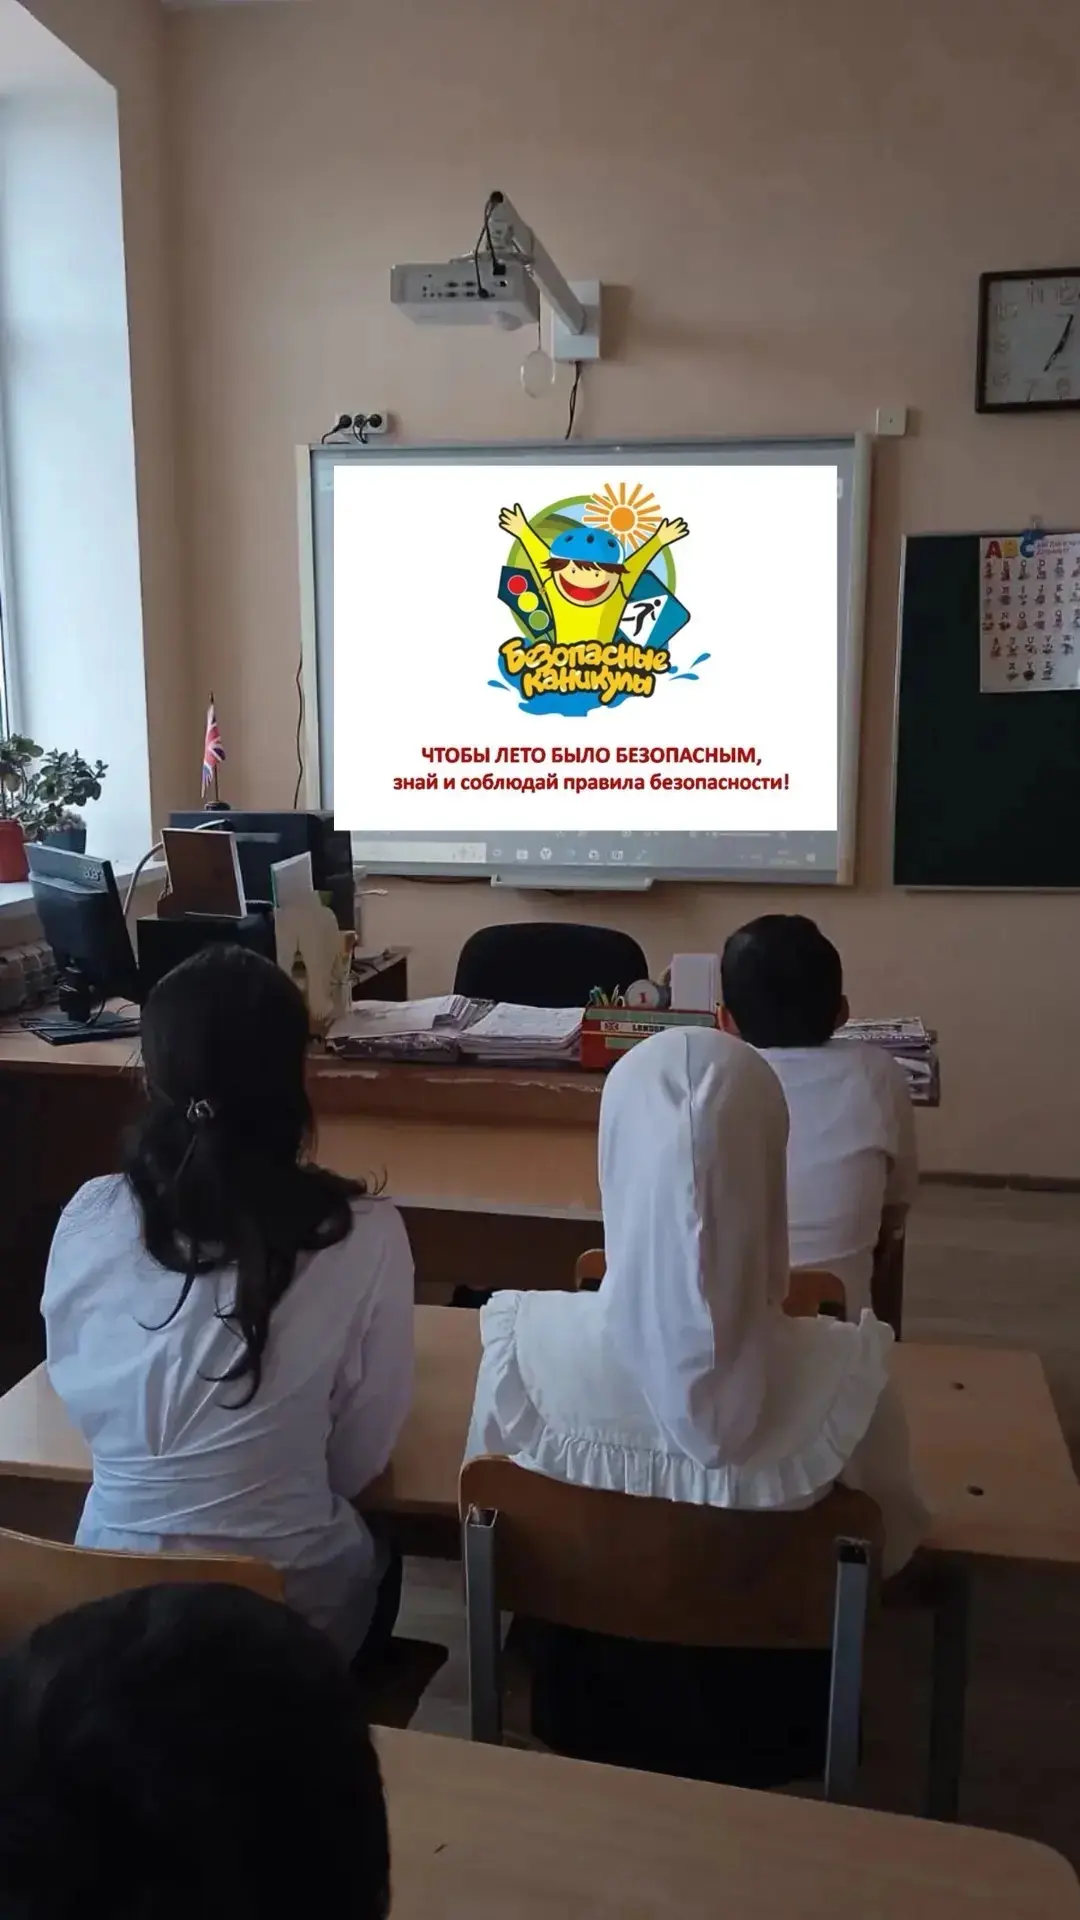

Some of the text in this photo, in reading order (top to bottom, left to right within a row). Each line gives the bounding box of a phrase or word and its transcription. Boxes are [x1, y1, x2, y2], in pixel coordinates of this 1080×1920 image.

[501, 638, 669, 674] Безопасные
[421, 746, 762, 767] ЧТОБЫ ЛЕТО БЫЛО БЕЗОПАСНЫМ,
[394, 772, 789, 794] знай и соблюдай правила безопасности!
